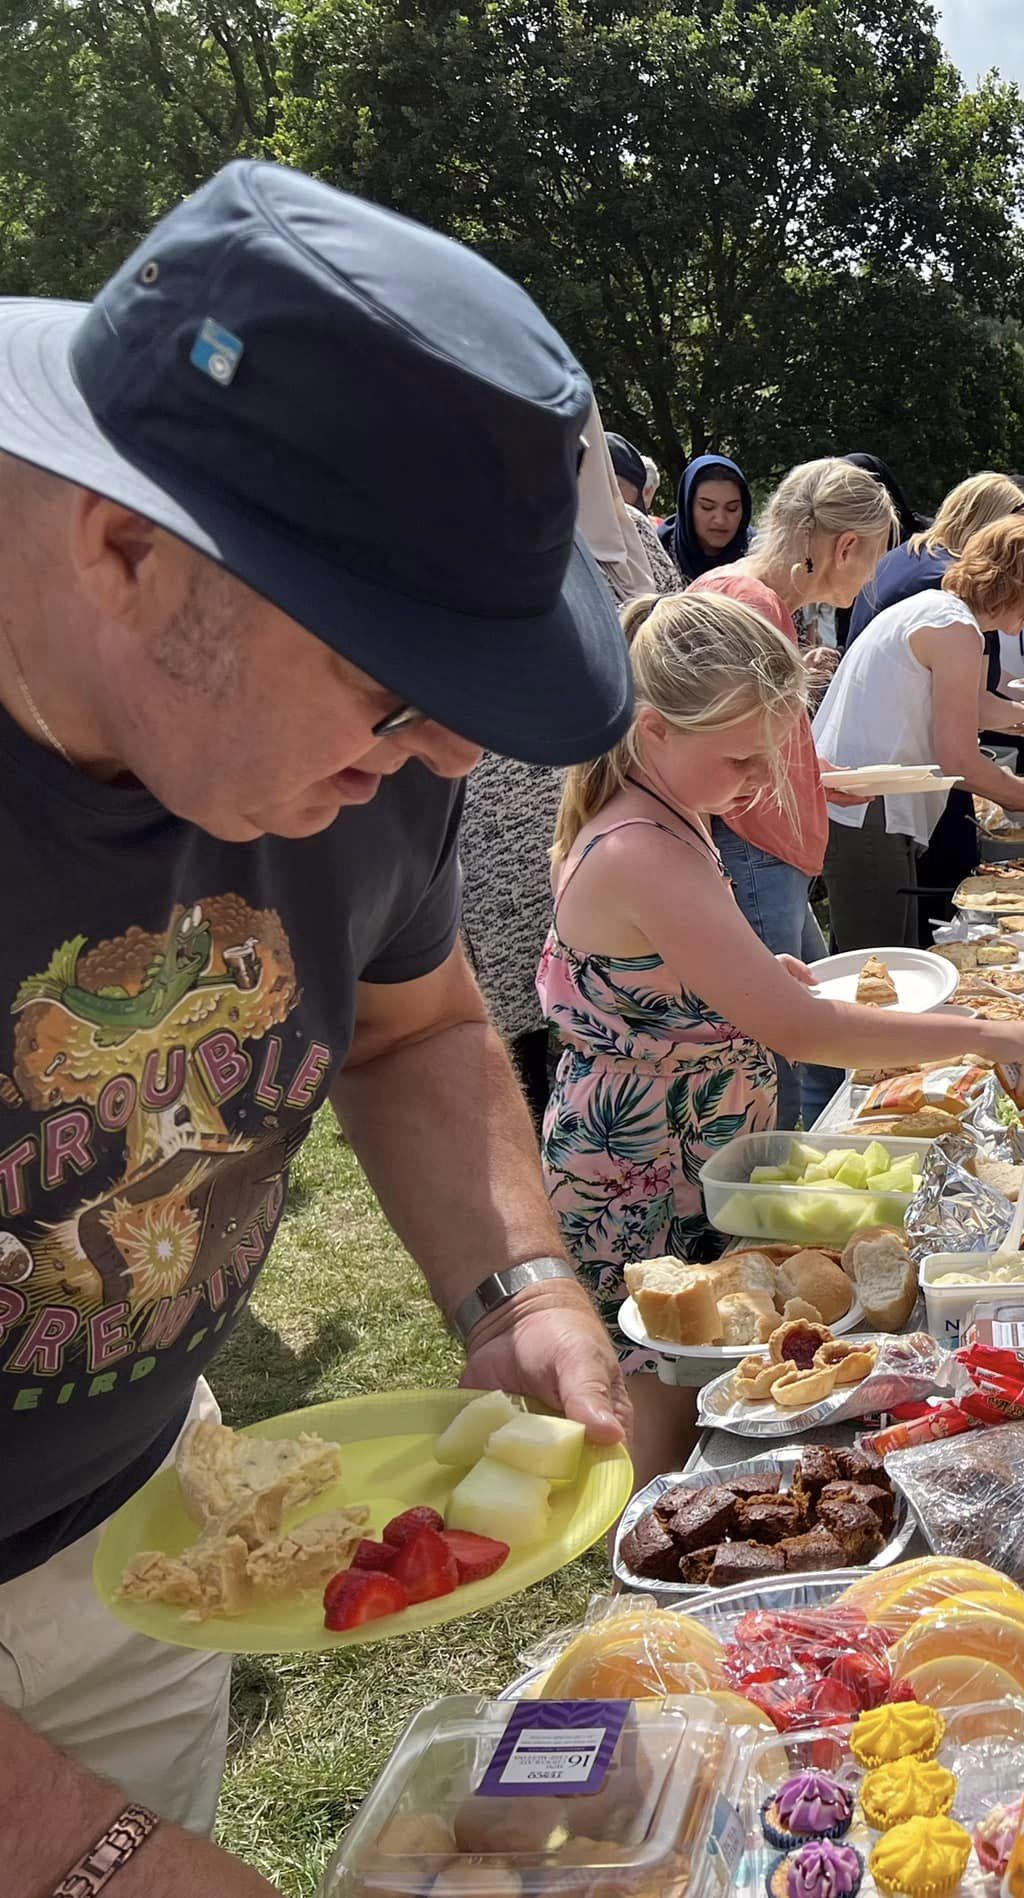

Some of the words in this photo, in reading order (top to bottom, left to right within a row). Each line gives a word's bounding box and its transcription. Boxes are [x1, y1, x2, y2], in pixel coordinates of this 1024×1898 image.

[0, 1028, 331, 1219] TROUBLE
[567, 1754, 590, 1768] 16
[527, 1771, 564, 1779] TESCO
